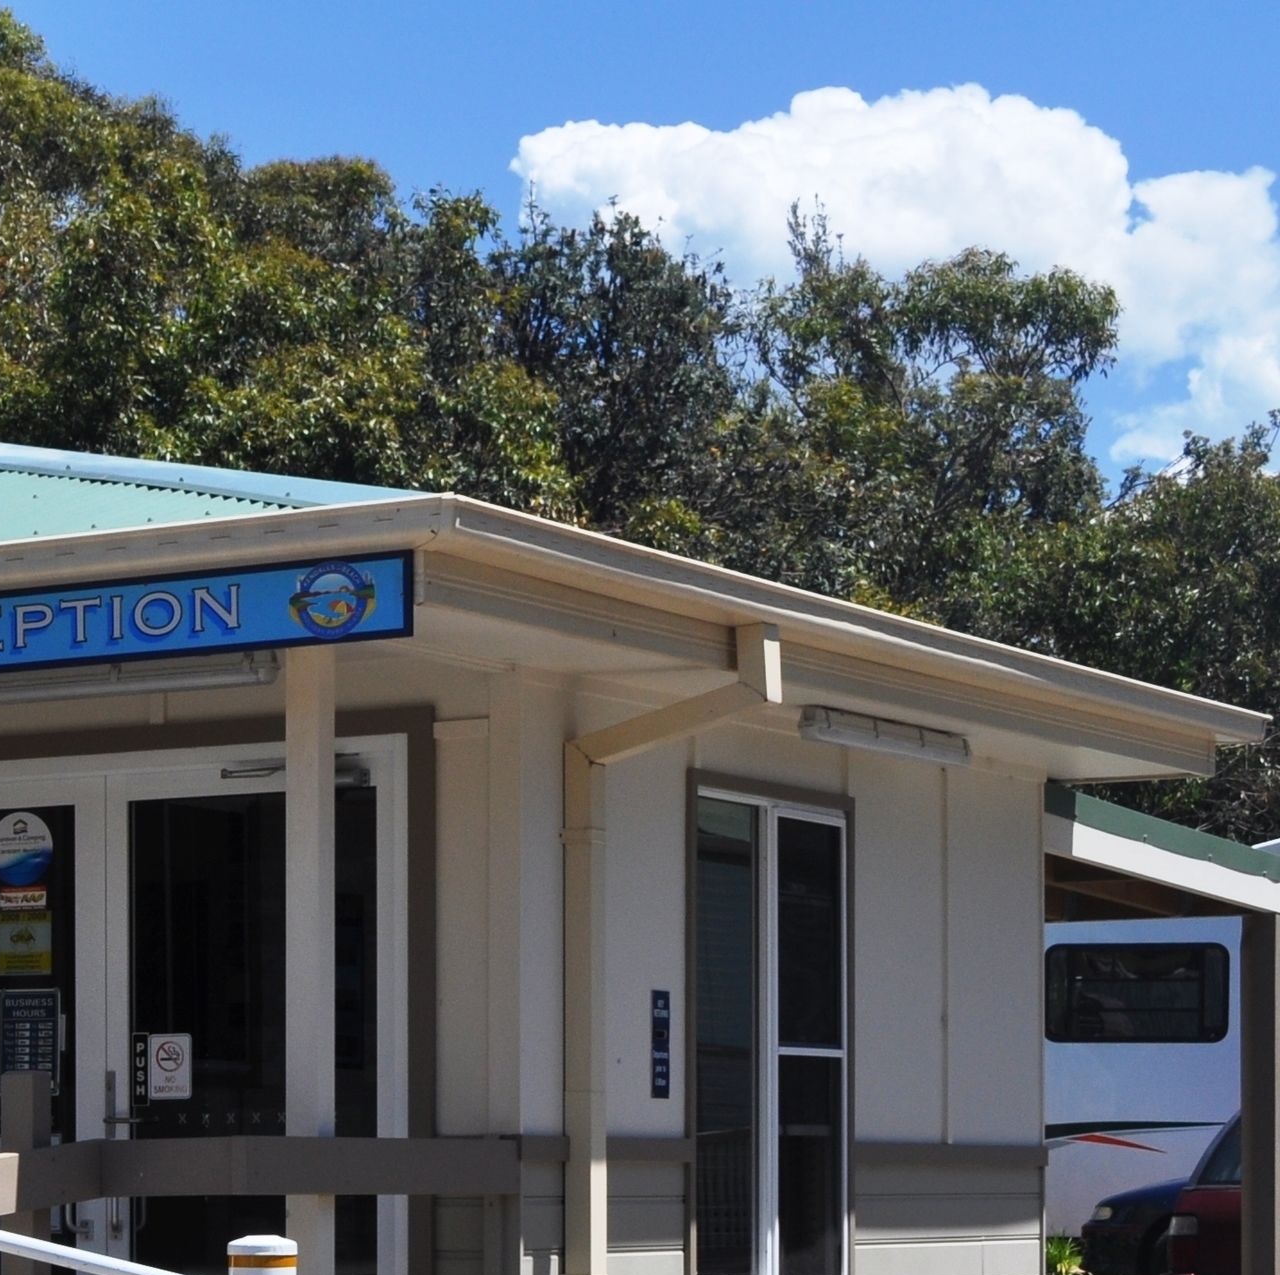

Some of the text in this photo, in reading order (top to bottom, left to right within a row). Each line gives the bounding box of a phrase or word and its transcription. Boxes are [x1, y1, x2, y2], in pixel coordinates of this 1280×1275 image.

[5, 998, 53, 1007] BUSINESS
[13, 1009, 46, 1018] HOURS
[135, 1042, 146, 1096] PUSH
